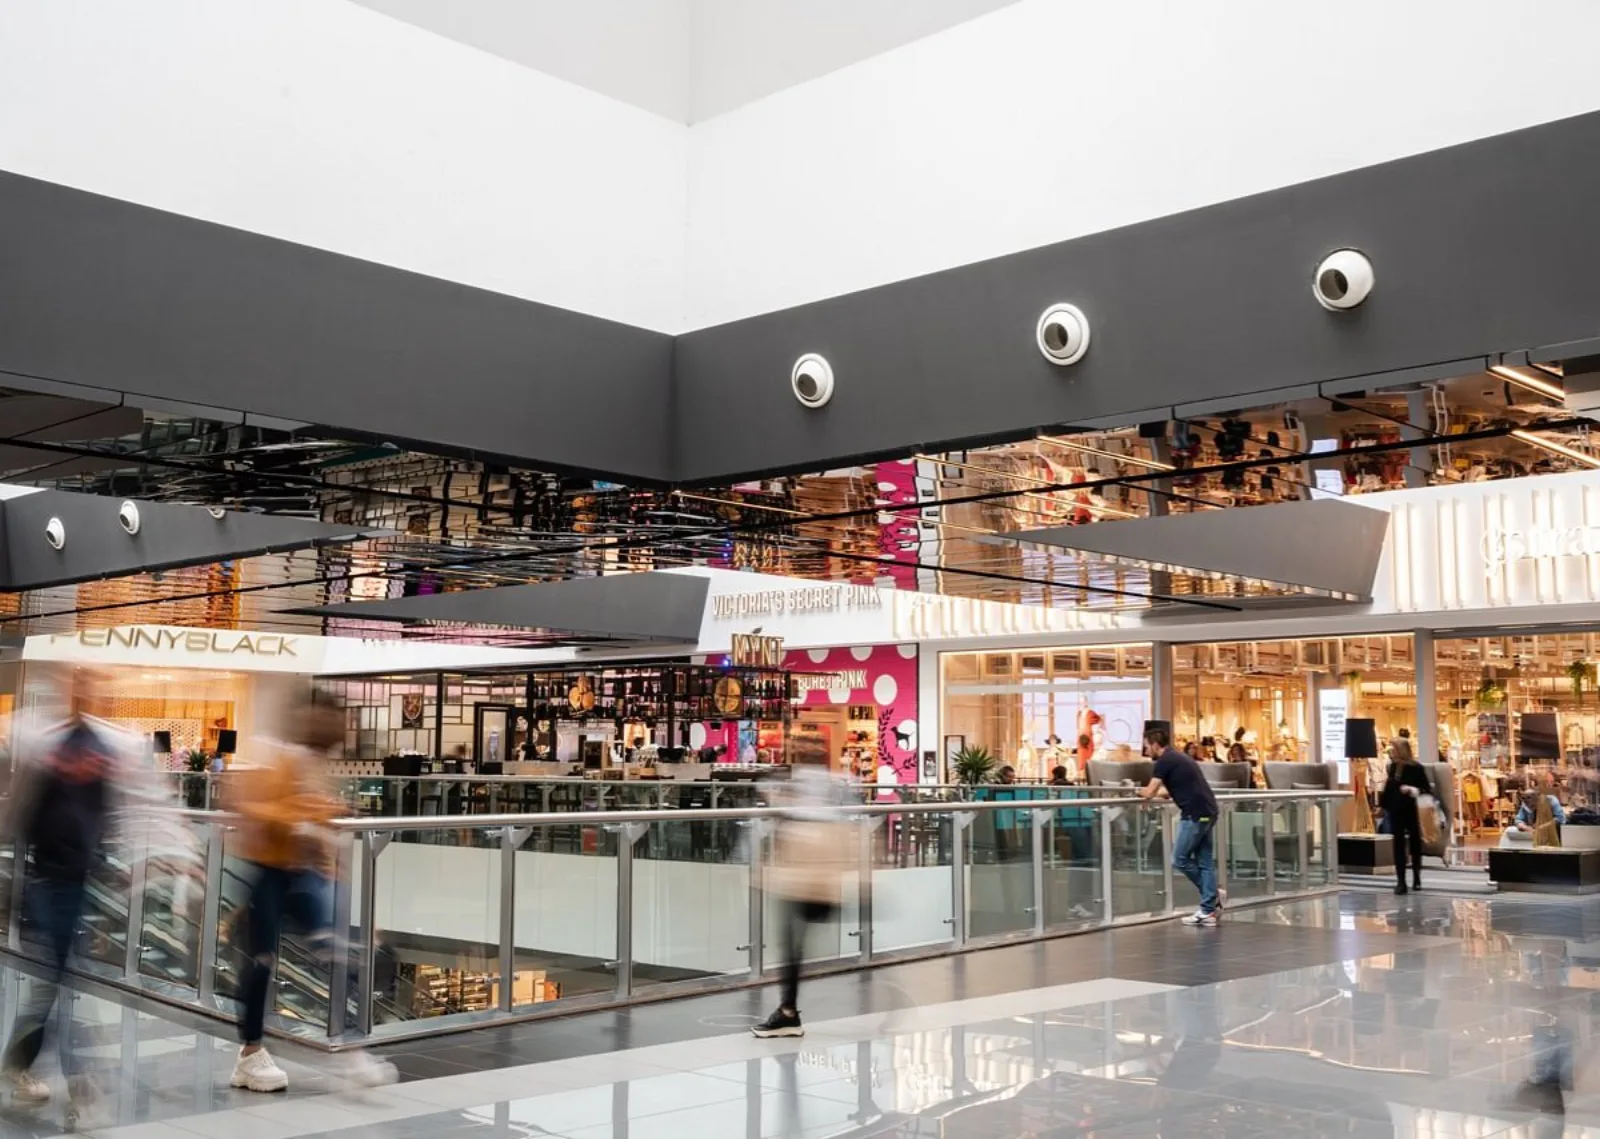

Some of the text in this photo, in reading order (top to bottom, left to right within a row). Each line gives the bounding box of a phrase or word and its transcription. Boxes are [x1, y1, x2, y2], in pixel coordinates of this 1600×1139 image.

[712, 585, 883, 616] VICTORIA'S SECRET PINK
[732, 633, 784, 666] MYNT
[835, 670, 868, 689] PINK
